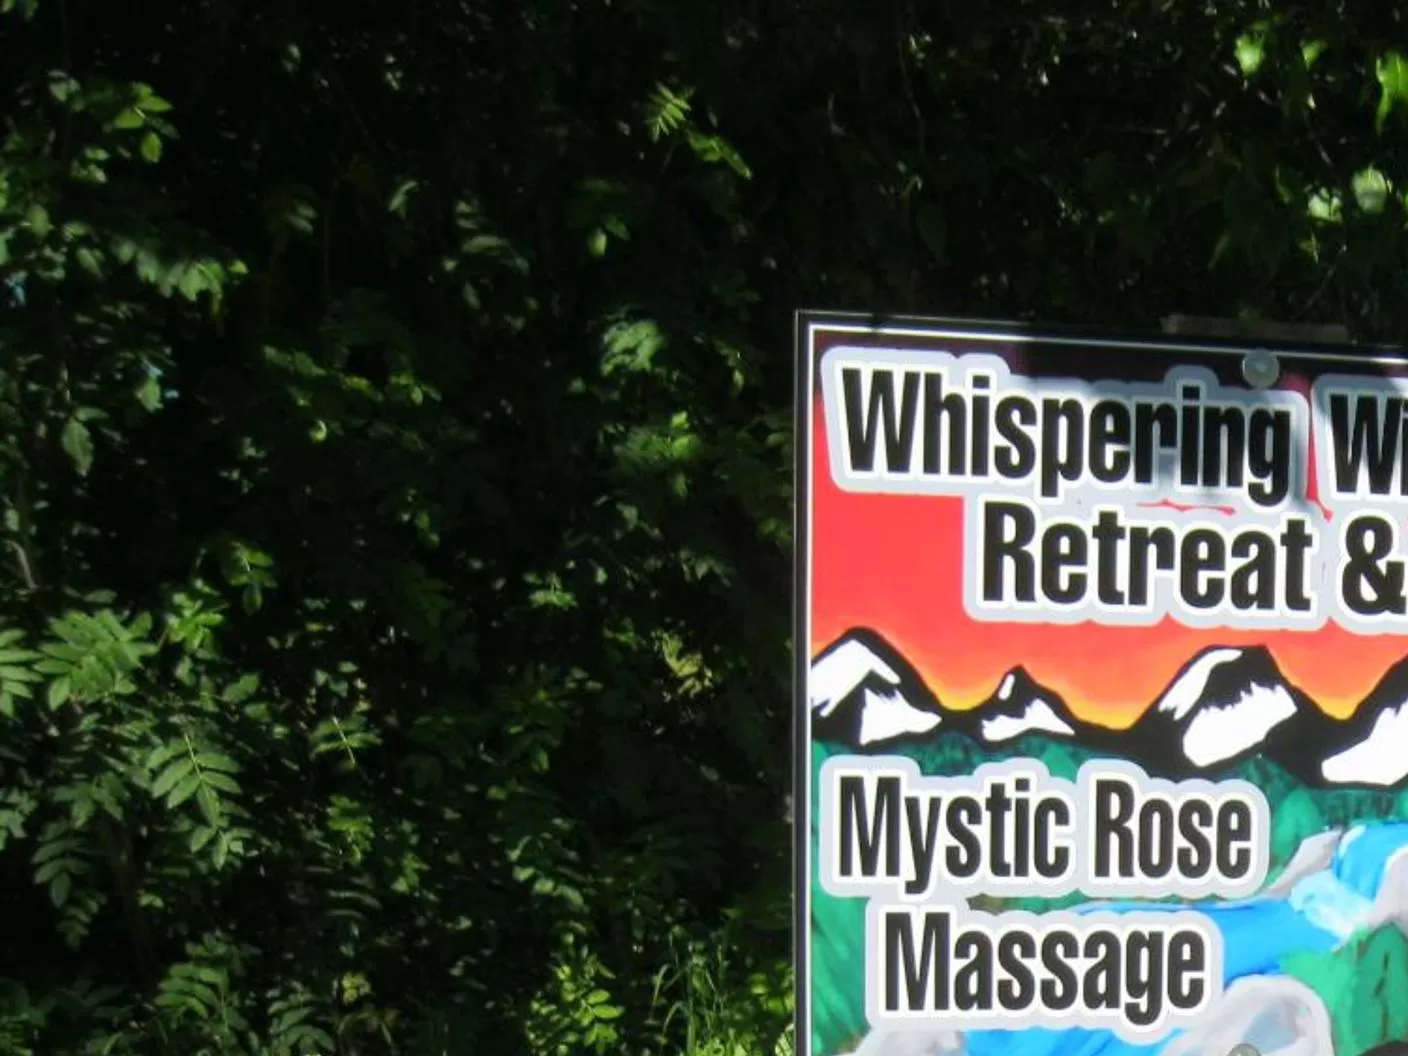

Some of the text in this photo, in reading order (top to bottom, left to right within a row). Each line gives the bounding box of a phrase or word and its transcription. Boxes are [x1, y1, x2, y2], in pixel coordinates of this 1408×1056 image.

[842, 367, 1291, 506] Whispering
[983, 501, 1408, 615] Retreat &
[839, 776, 1253, 894] Mystic Rose
[885, 912, 1206, 1026] Massage
